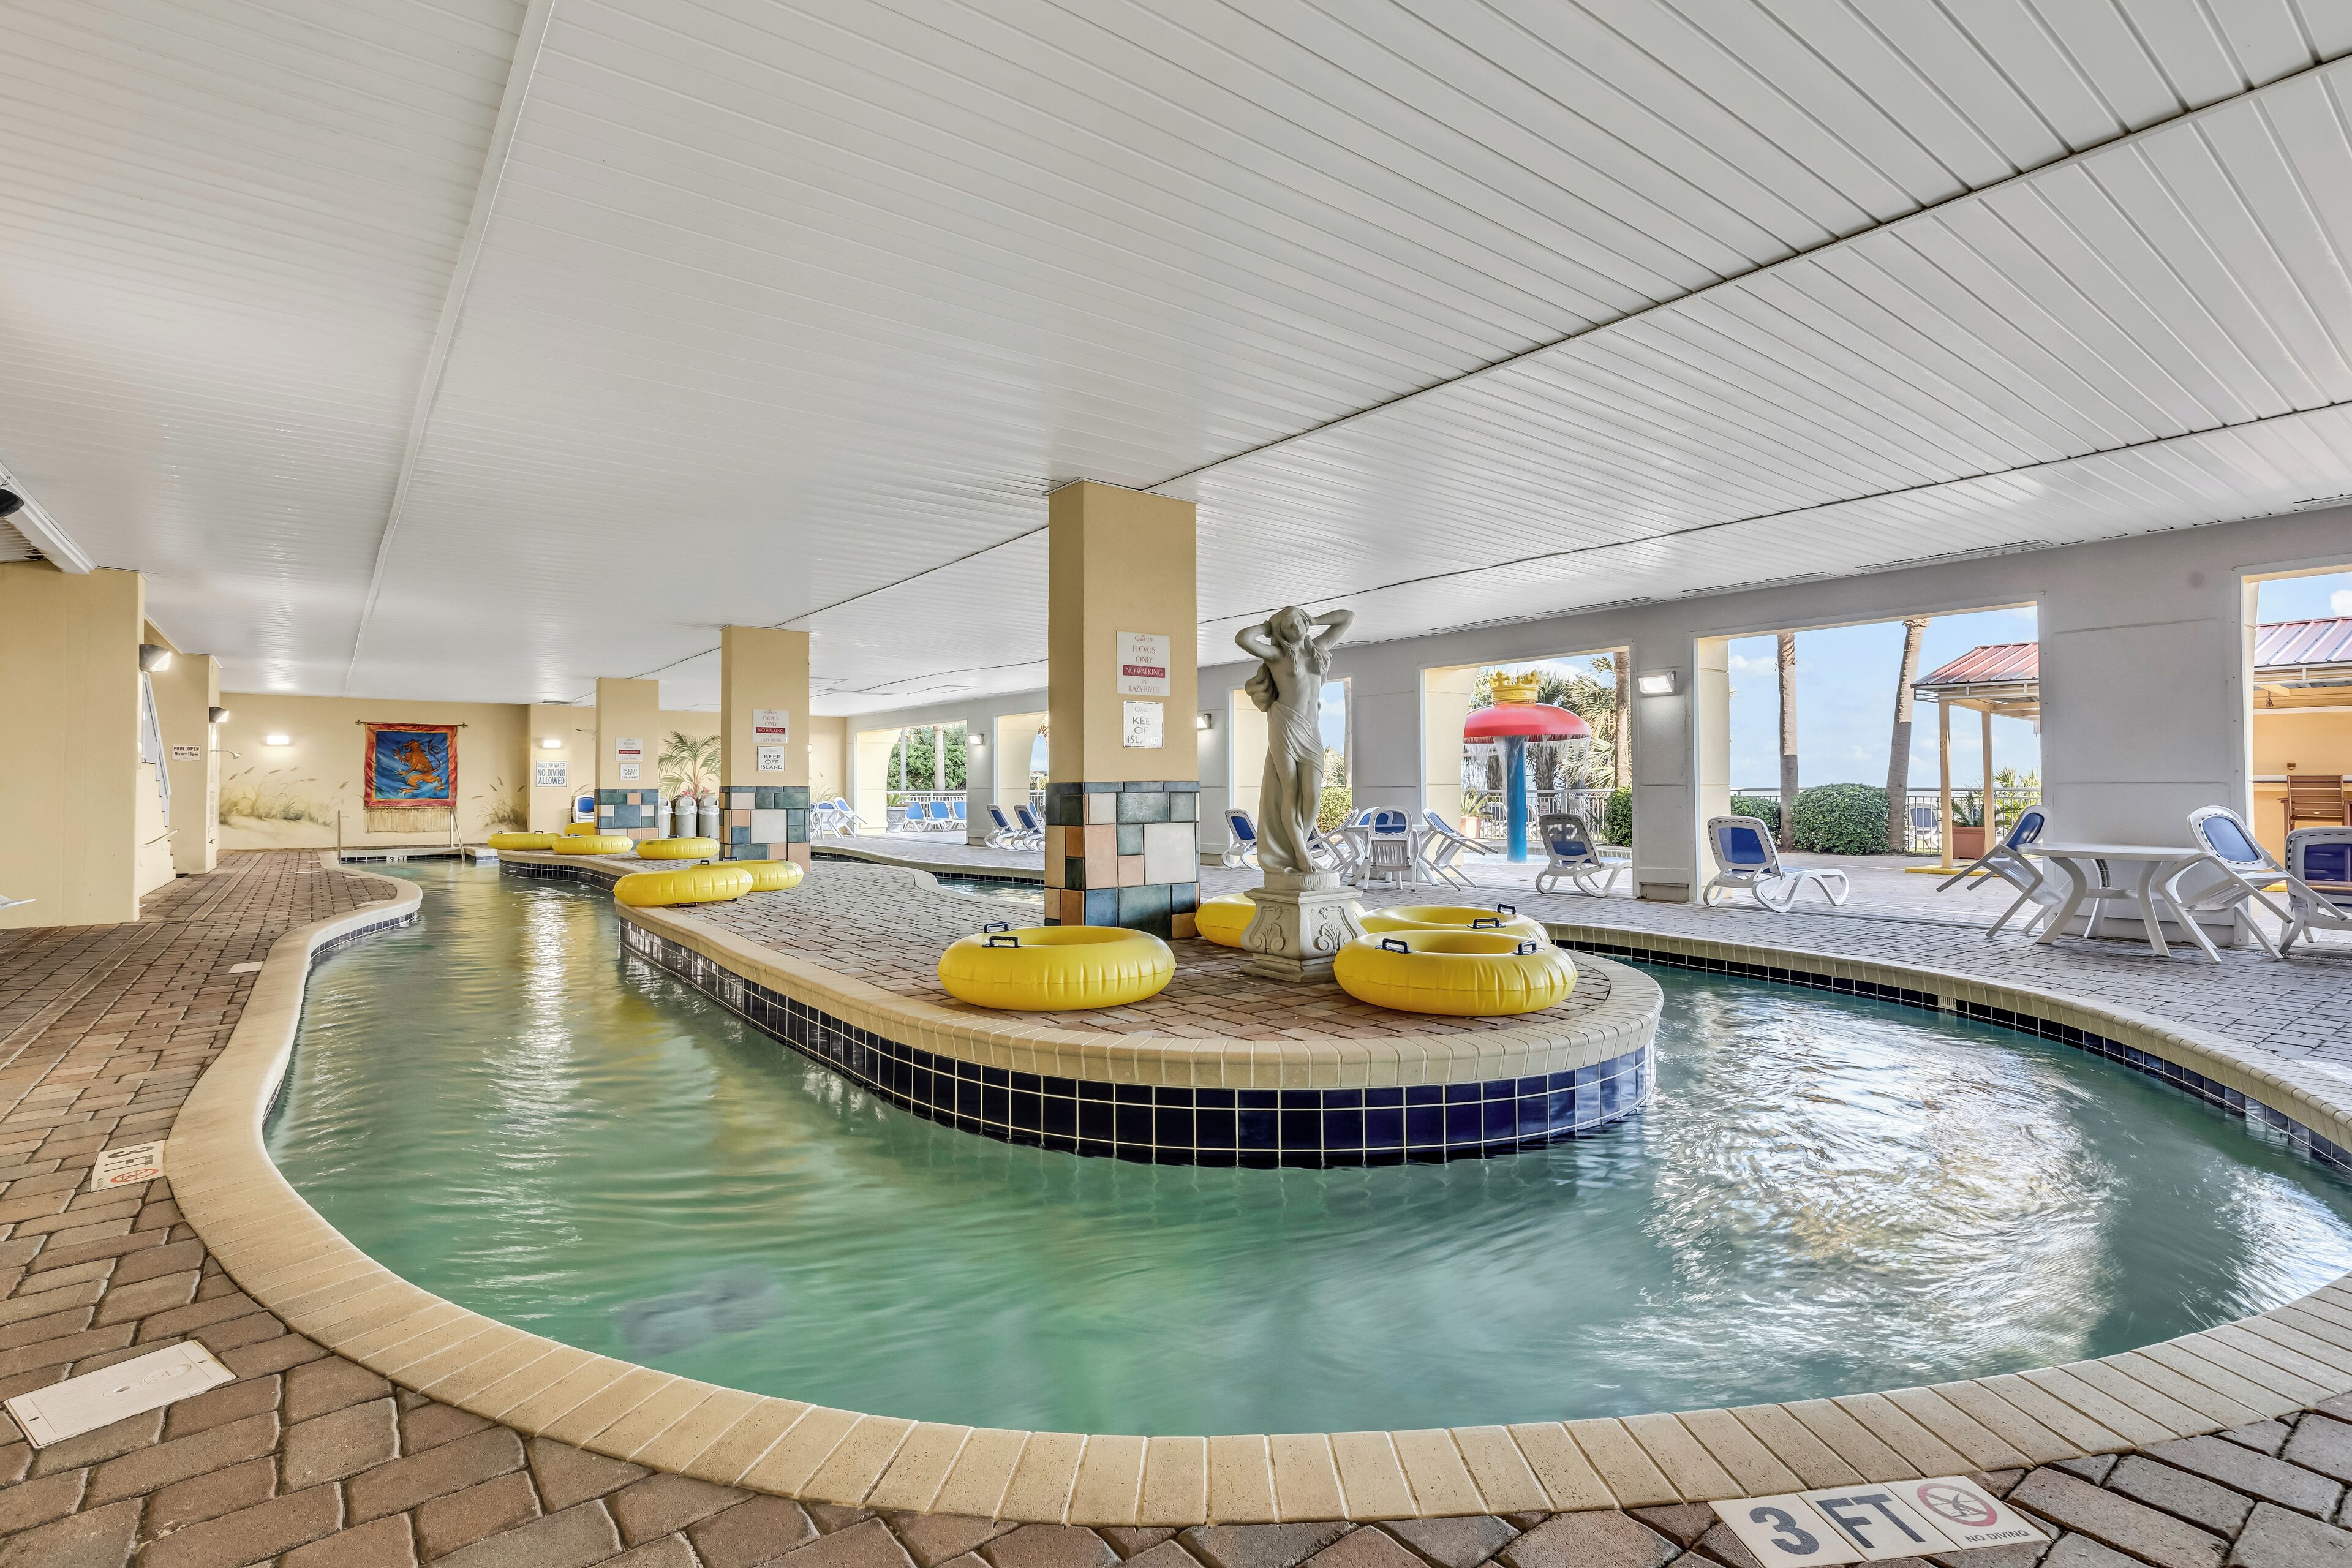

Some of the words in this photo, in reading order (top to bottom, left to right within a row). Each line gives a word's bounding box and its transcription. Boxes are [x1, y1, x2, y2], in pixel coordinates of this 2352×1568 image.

[1133, 645, 1156, 654] FLOATS
[1136, 666, 1163, 676] WALKING
[1128, 736, 1160, 744] ISLND
[108, 1146, 154, 1158] 3
[103, 1155, 154, 1172] FT
[1749, 1506, 1820, 1555] 3
[1815, 1493, 1926, 1549] FT
[1986, 1530, 2030, 1540] DIVING
